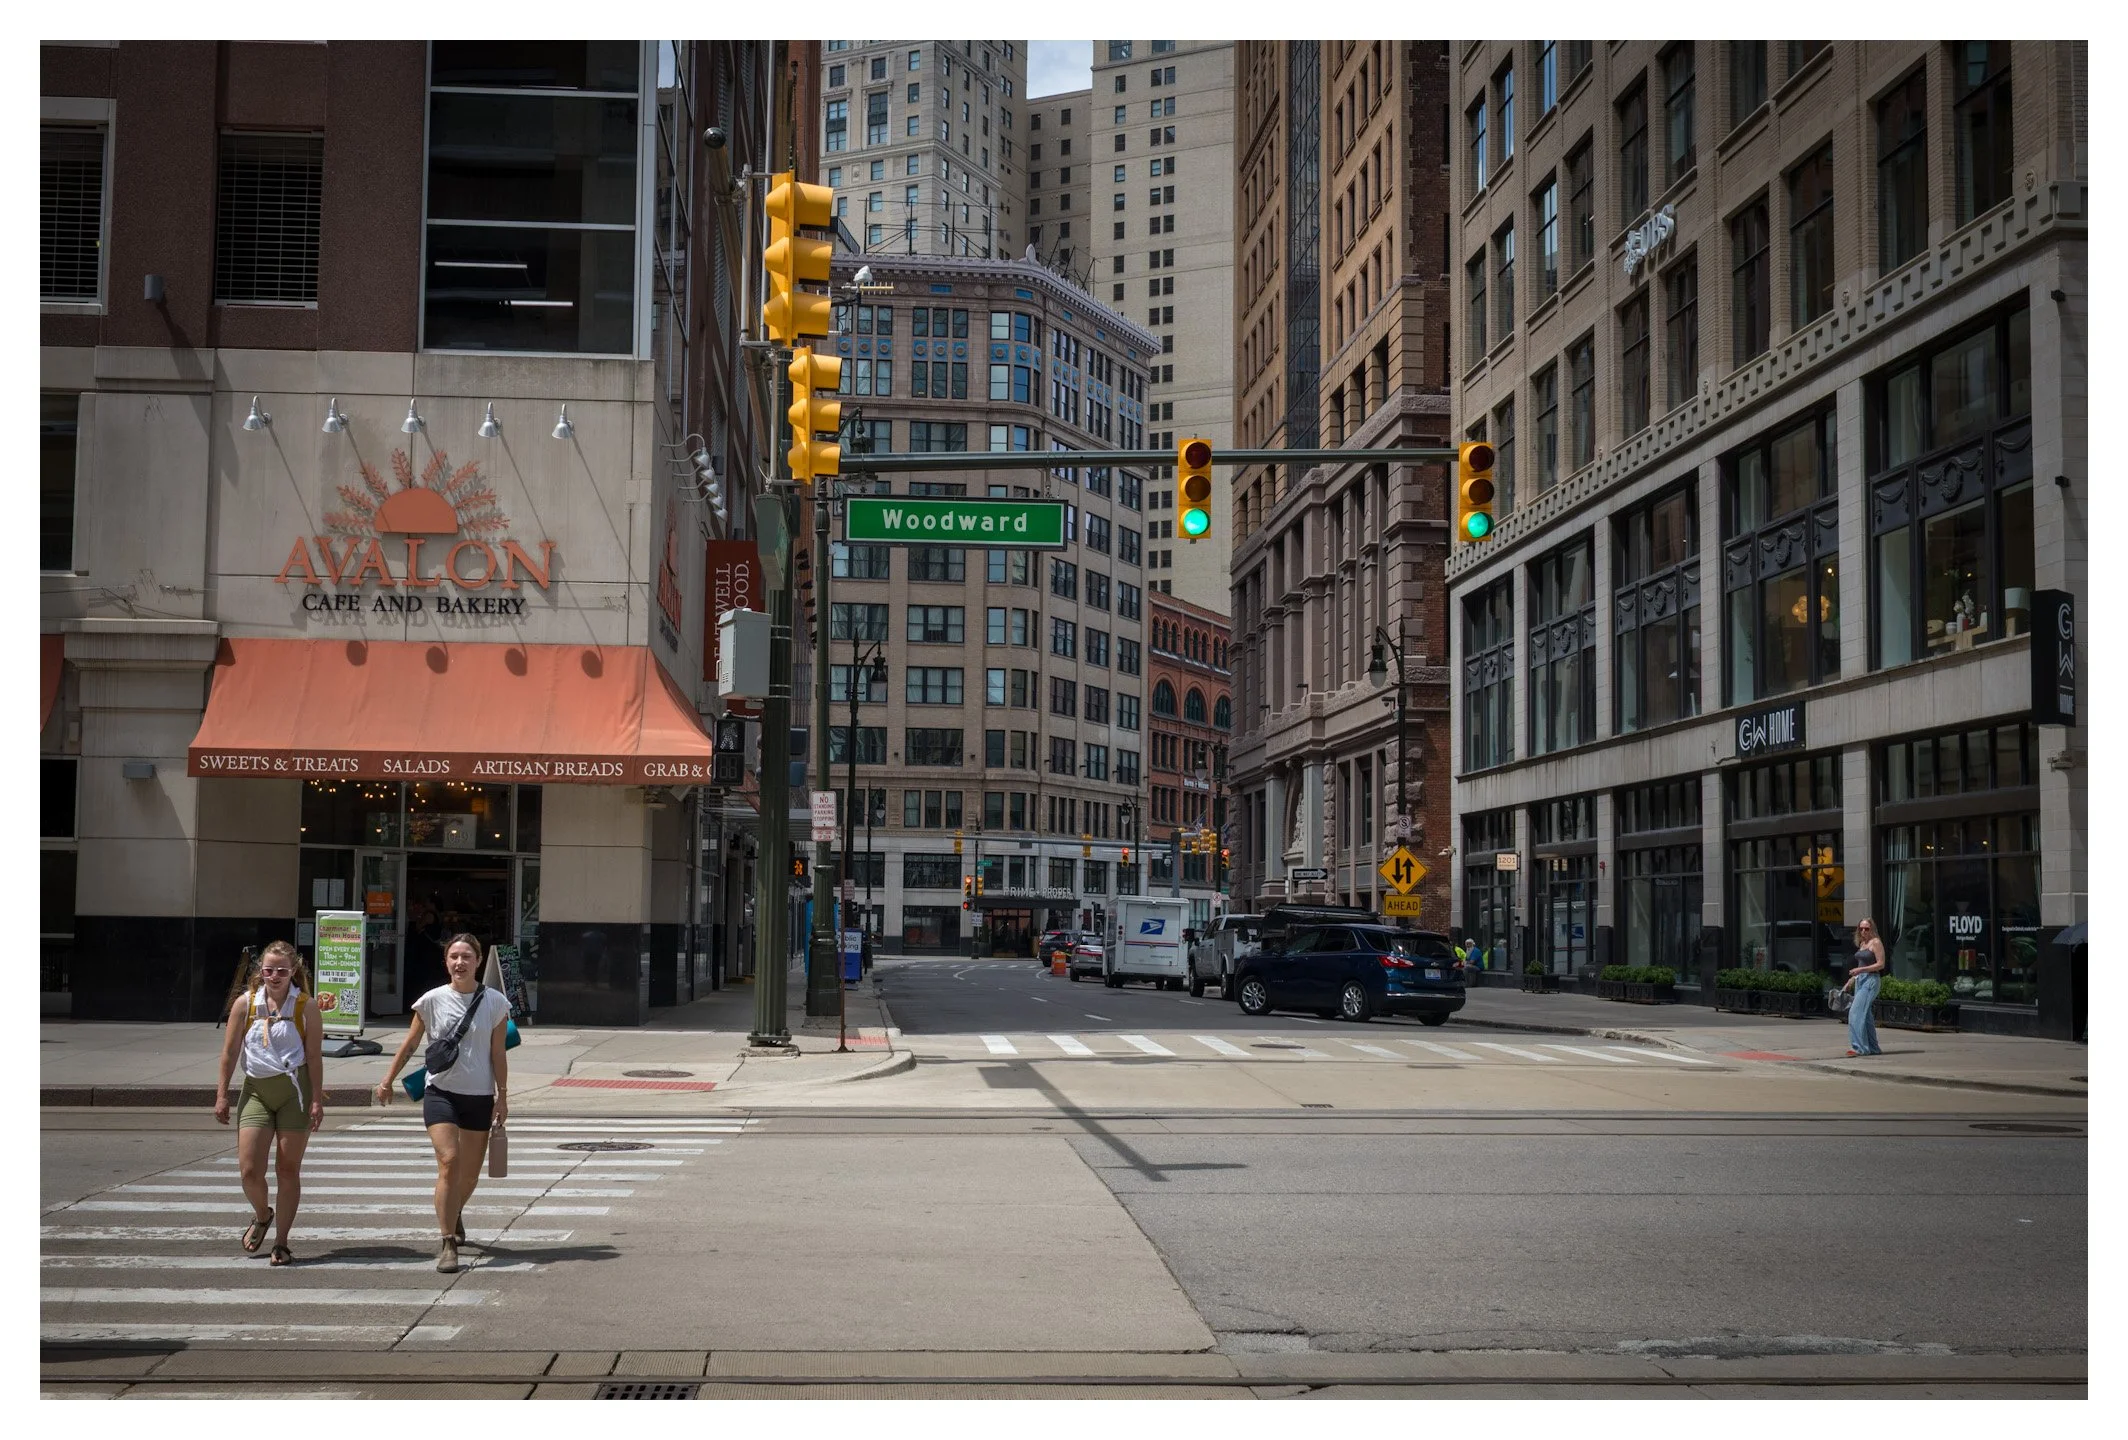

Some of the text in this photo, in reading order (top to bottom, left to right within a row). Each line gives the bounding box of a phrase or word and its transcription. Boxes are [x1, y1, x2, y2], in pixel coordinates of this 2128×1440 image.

[882, 508, 1027, 533] Woodward
[273, 536, 557, 590] AVALON
[715, 563, 731, 617] WELL
[734, 560, 750, 609] OOD.
[302, 593, 526, 615] CAFE AND BAKERY
[1768, 708, 1795, 746] HOME
[199, 755, 270, 771] SWEETS
[273, 757, 289, 772] &
[292, 757, 360, 772] TREATS
[383, 759, 450, 774] SALADS
[472, 761, 550, 776] ARTISAN
[553, 762, 624, 777] BREADS
[644, 762, 689, 777] GRAB
[691, 764, 704, 778] &
[819, 796, 829, 804] NO
[1003, 886, 1035, 898] PRIME
[1042, 887, 1072, 899] PROPER
[1387, 901, 1419, 911] AHEAD
[1949, 916, 1983, 934] FLOYD
